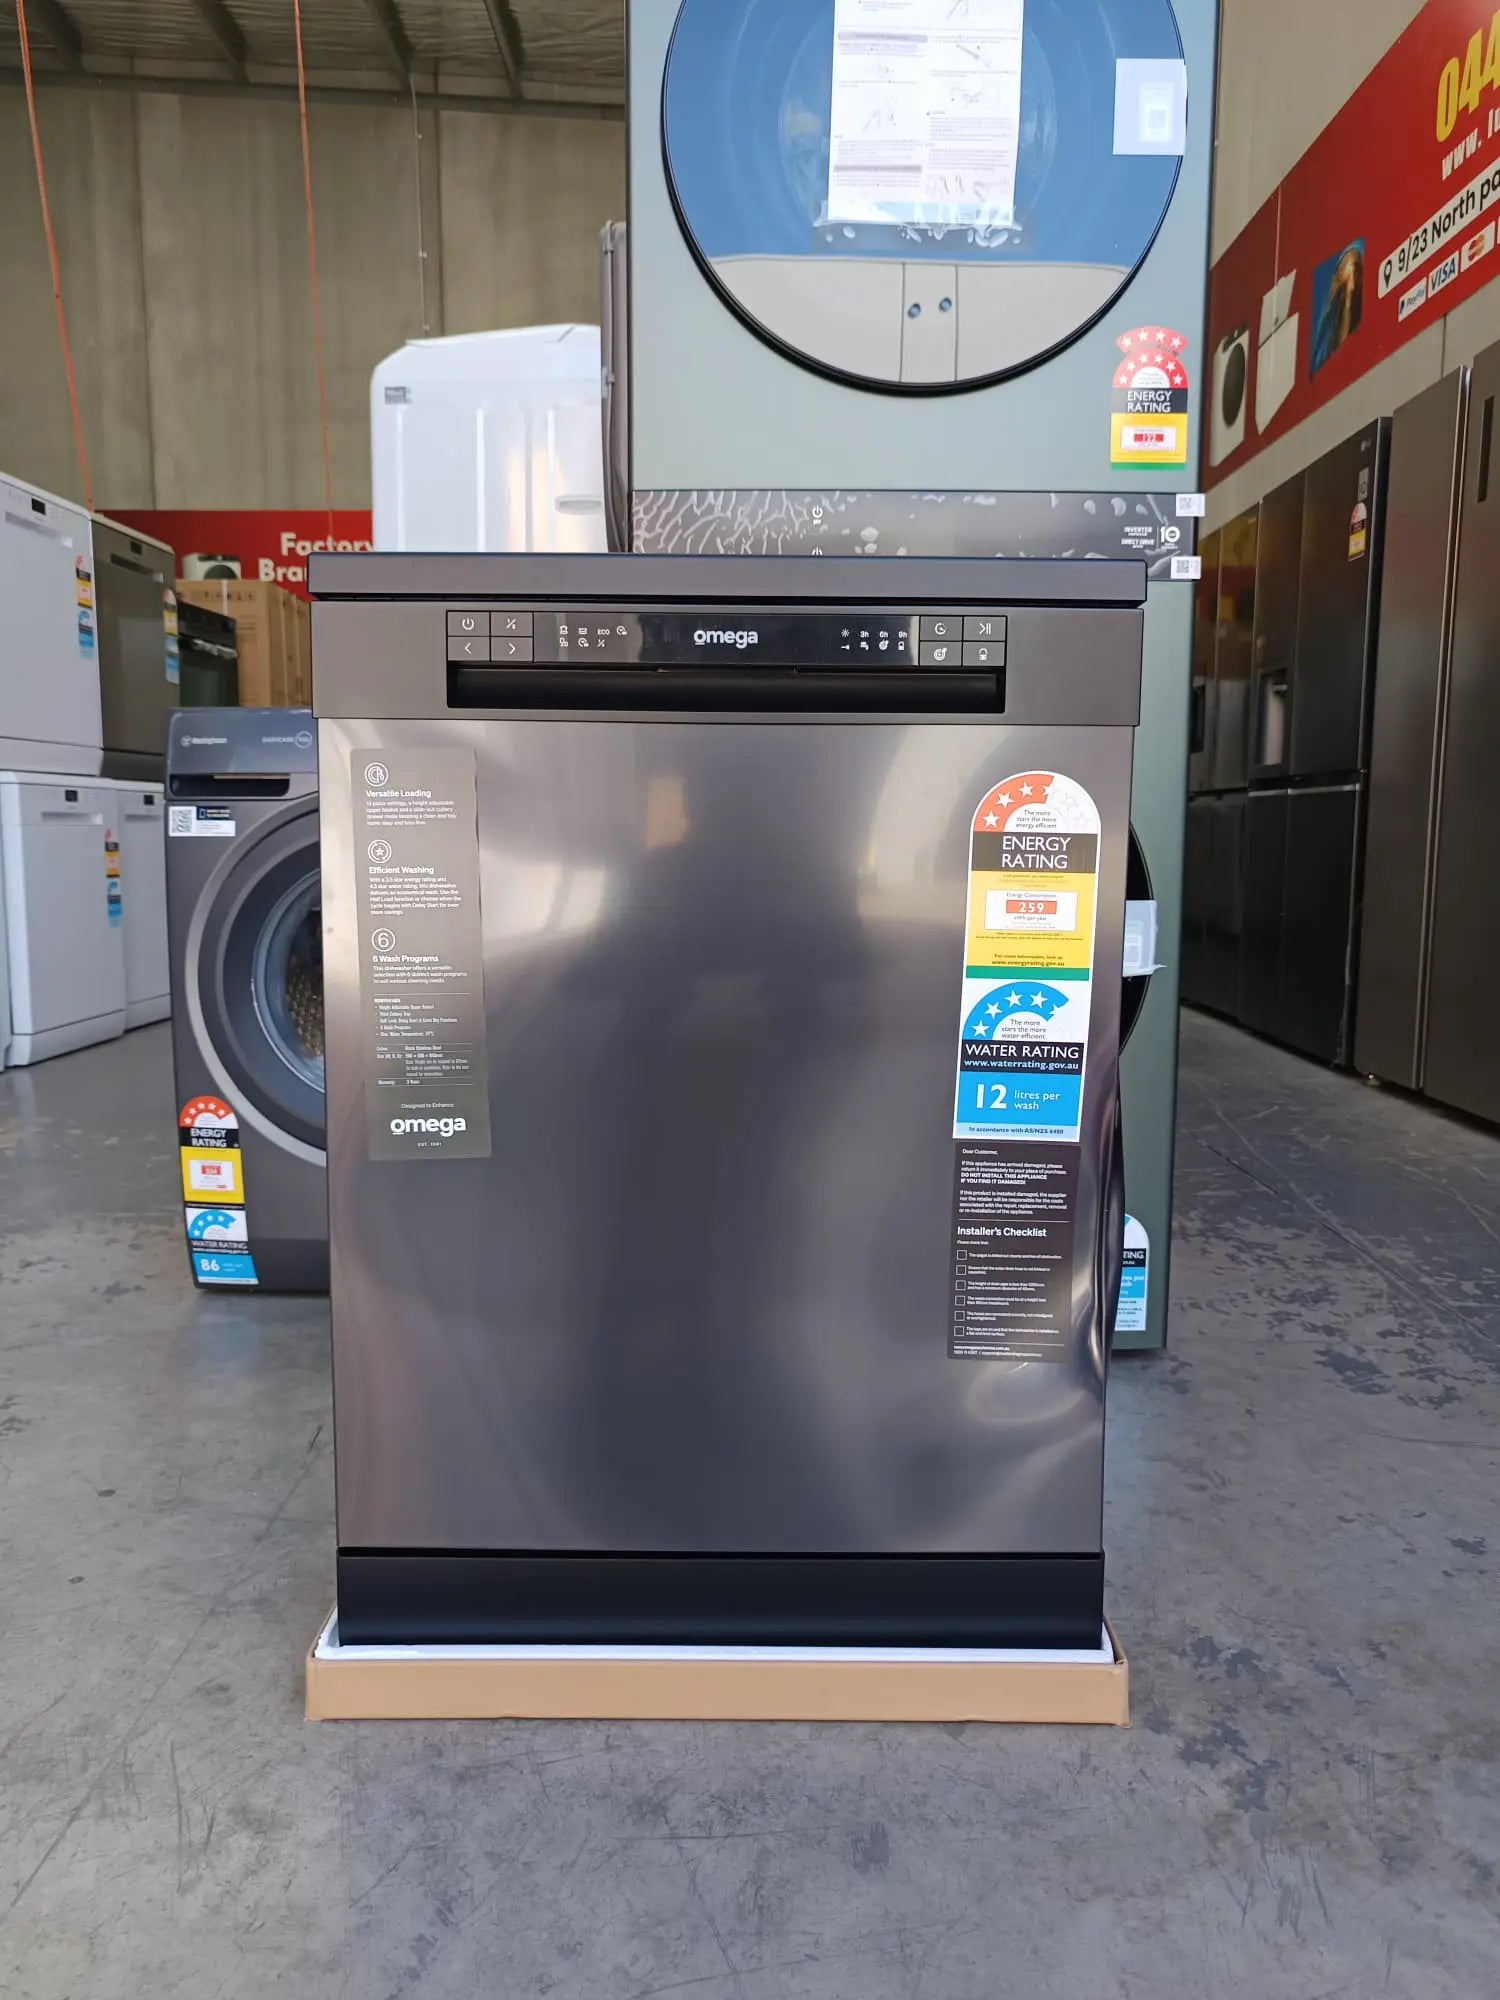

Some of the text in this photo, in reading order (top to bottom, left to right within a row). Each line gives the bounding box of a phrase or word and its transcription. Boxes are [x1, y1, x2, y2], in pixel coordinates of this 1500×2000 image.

[1442, 127, 1482, 181] www.
[1398, 228, 1428, 273] 9/23
[1431, 188, 1476, 244] North
[1431, 257, 1456, 291] VISA
[1128, 391, 1172, 402] ENERGY
[1128, 402, 1170, 412] RATING
[258, 559, 307, 582] Bra
[694, 629, 759, 648] omega
[400, 790, 431, 798] Loading
[1002, 836, 1071, 851] ENERGY
[1002, 854, 1068, 870] RATING
[1019, 902, 1044, 912] 259
[378, 932, 390, 948] 6
[966, 1044, 1079, 1058] WATER RATING
[964, 1060, 1078, 1070] www.waterrating.gov.au
[976, 1083, 1007, 1109] 12
[1014, 1089, 1061, 1102] litres per
[1014, 1101, 1039, 1109] wash
[191, 1128, 228, 1138] ENERGY
[391, 1118, 466, 1137] omega
[192, 1138, 227, 1148] RATING
[957, 1226, 1047, 1236] Installer's Checklist
[200, 1259, 220, 1272] 86
